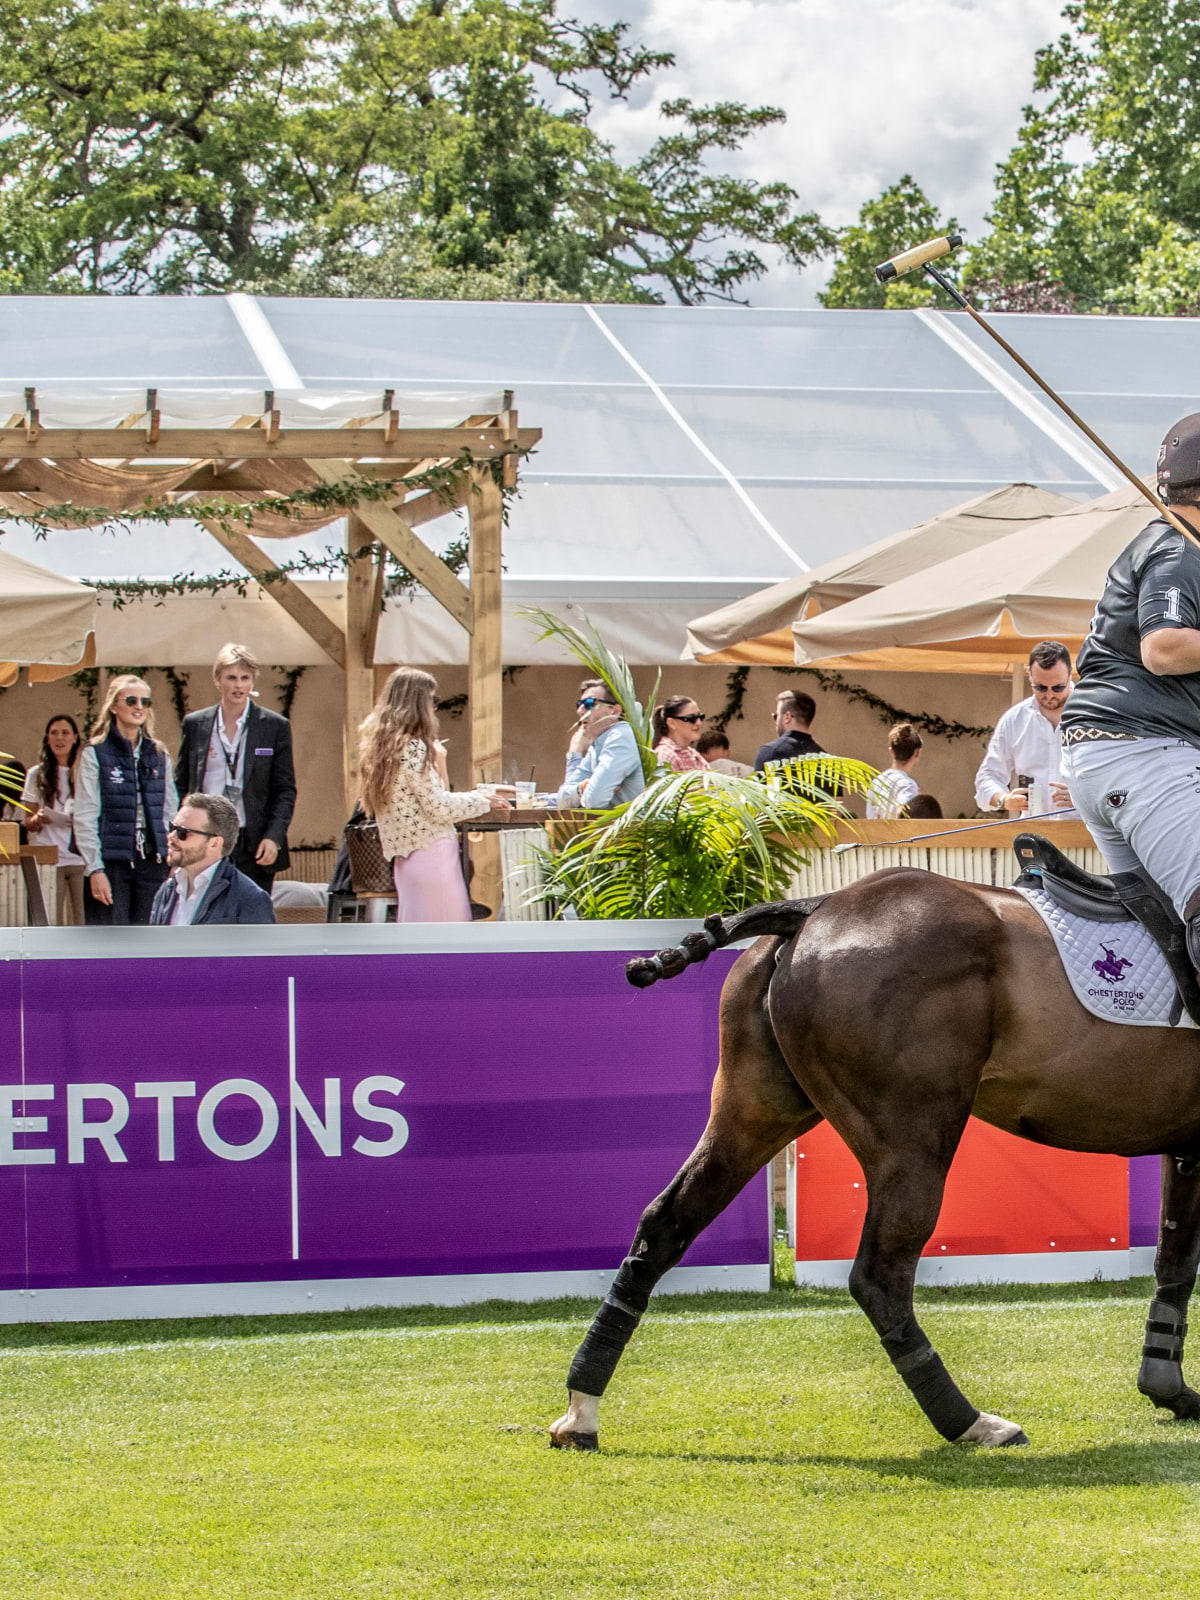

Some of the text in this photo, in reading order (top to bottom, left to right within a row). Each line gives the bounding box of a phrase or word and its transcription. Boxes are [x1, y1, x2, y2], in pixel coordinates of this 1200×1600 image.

[1163, 586, 1182, 623] 1
[1087, 988, 1145, 1000] CHESTERTONS
[1113, 998, 1136, 1006] POLO
[0, 1074, 410, 1166] ERTONS
